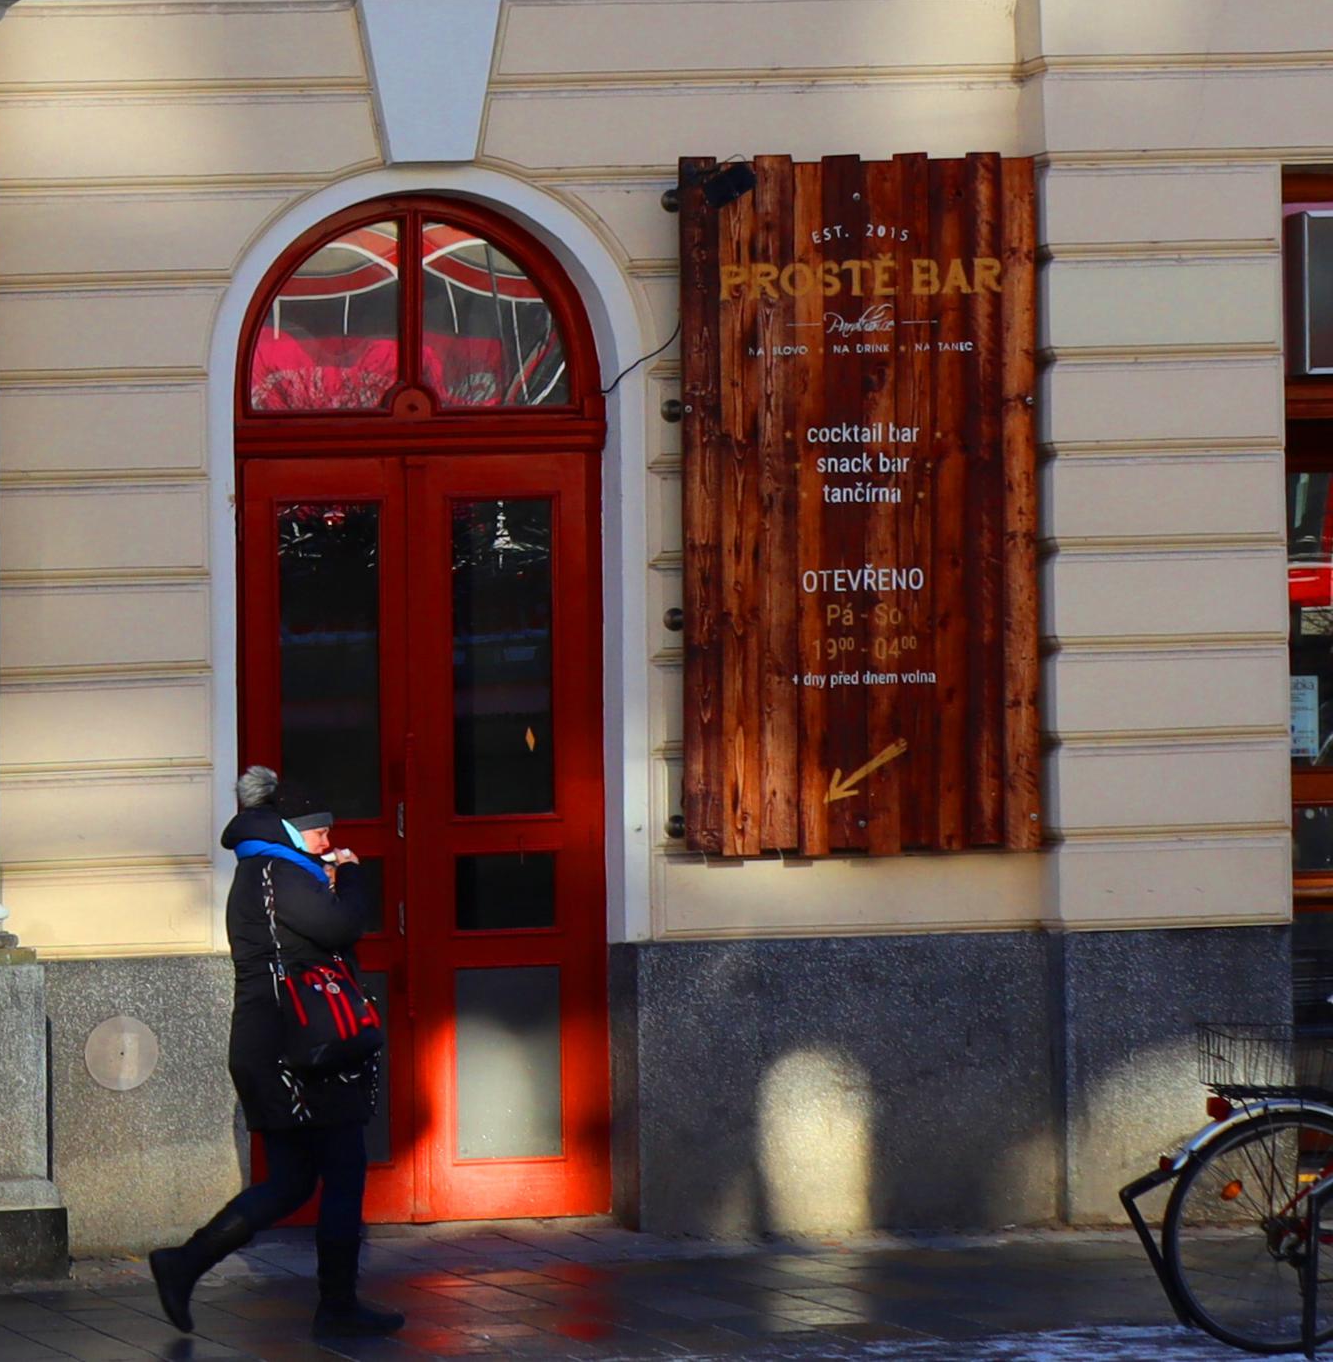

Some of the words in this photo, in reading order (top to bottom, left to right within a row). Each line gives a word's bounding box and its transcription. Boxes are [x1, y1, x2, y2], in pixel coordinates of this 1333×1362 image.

[812, 225, 850, 244] EST.
[865, 224, 909, 241] 2015
[719, 253, 897, 300] PROSTĚ
[911, 257, 1002, 295] BAR
[833, 345, 849, 353] NA
[856, 343, 889, 353] DRINK
[915, 343, 930, 351] NA
[938, 341, 974, 352] TANEC
[807, 422, 882, 444] cocktail
[888, 422, 919, 443] bar
[817, 453, 872, 473] snack
[878, 453, 909, 473] bar
[823, 482, 901, 504] tančírna
[803, 563, 924, 593] OTEVŘENO
[827, 602, 853, 626] Pá
[874, 602, 901, 625] So
[803, 672, 826, 689] dny
[830, 670, 859, 688] před
[862, 670, 898, 685] dnem
[901, 669, 936, 684] volna
